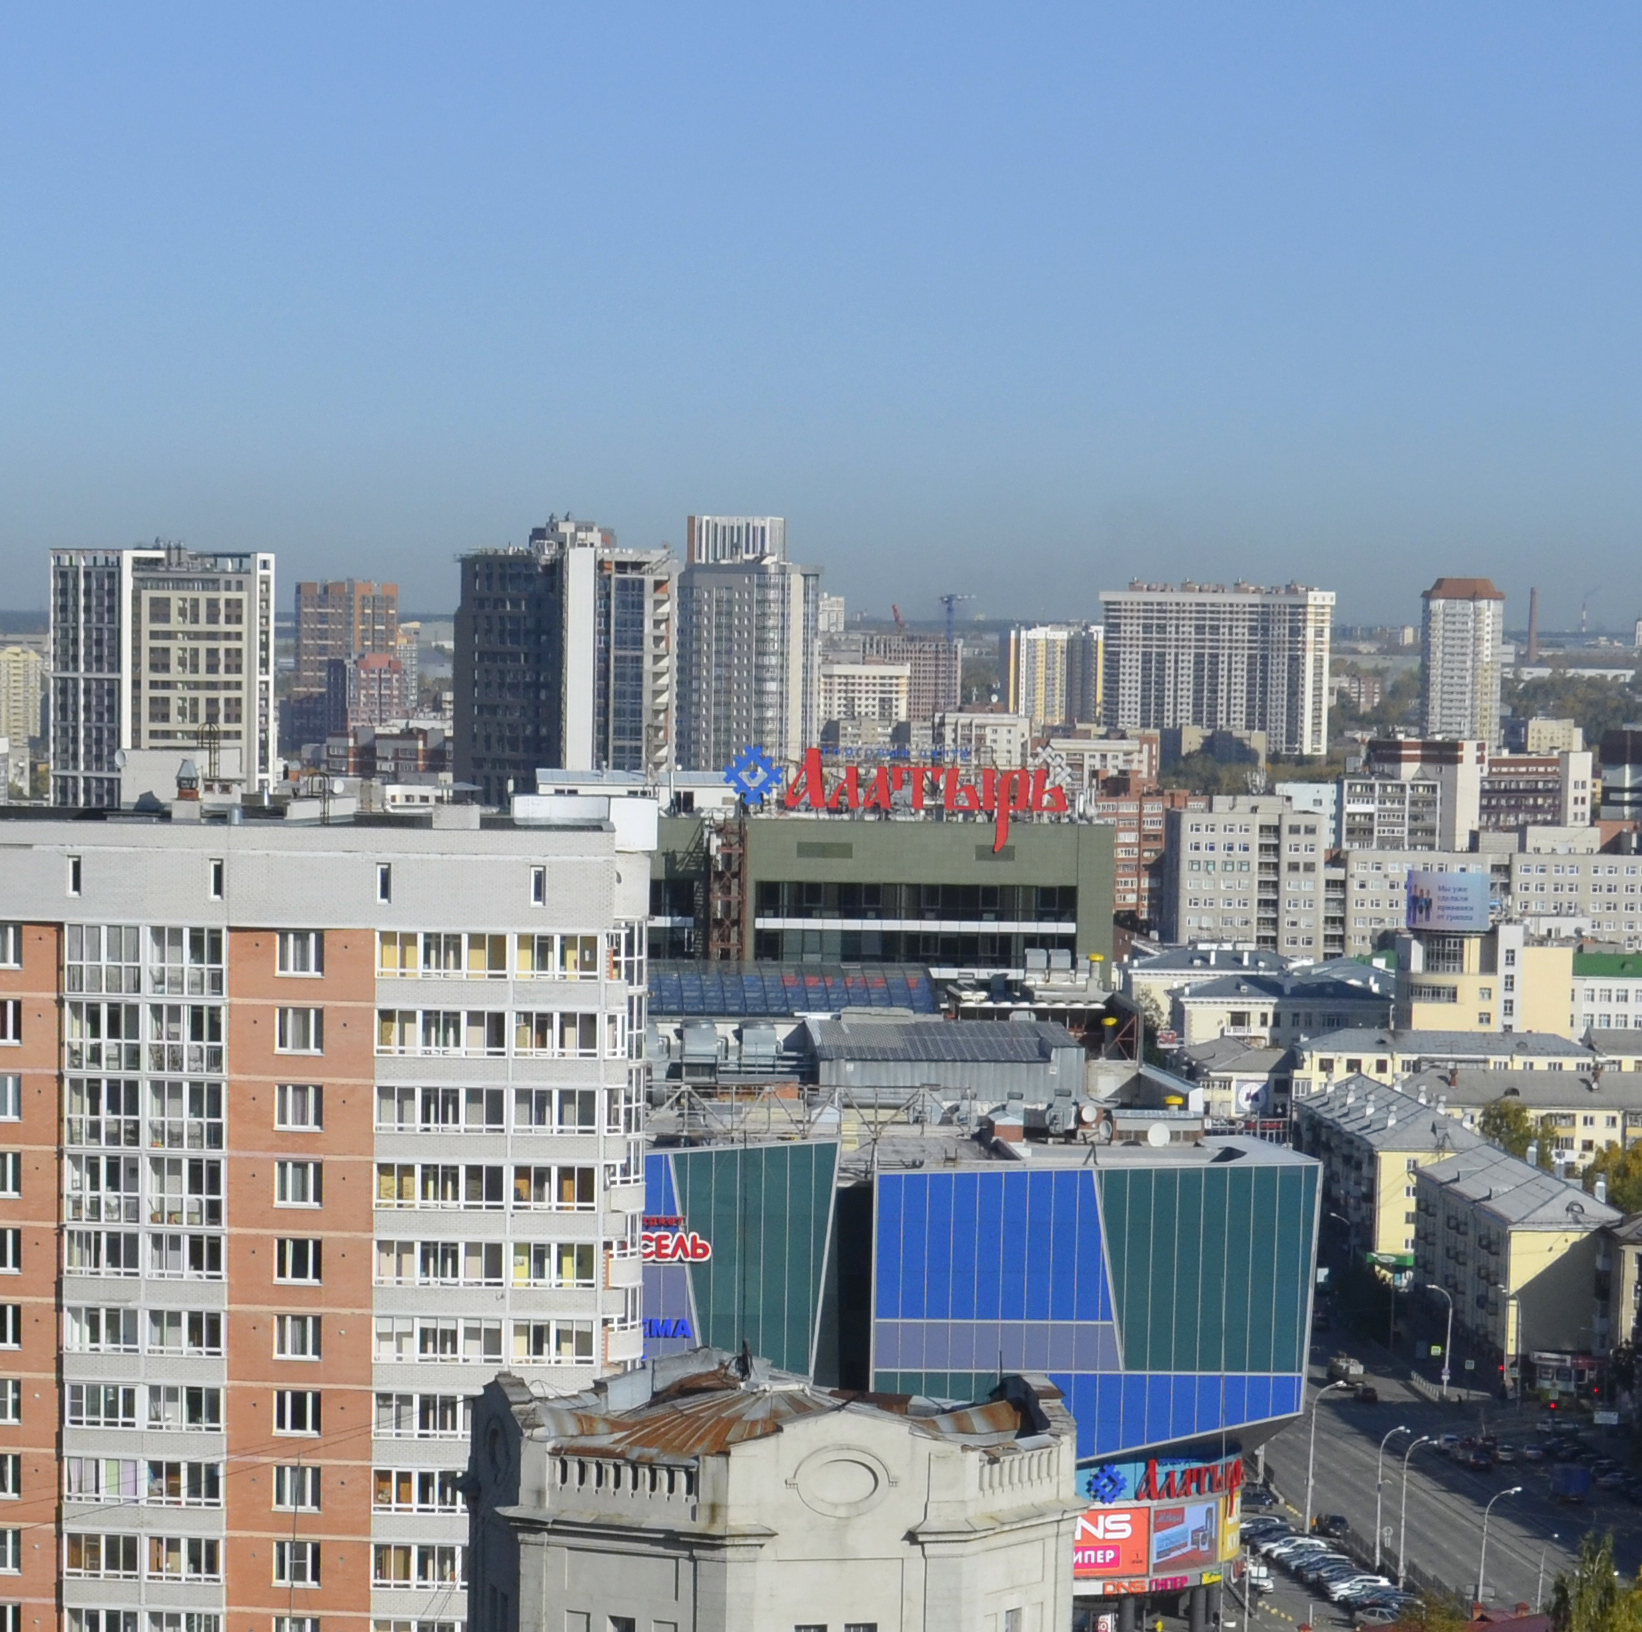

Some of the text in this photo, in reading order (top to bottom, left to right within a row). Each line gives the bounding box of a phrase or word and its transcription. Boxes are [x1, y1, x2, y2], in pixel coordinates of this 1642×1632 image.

[784, 748, 1068, 853] Алатырь
[1103, 1580, 1146, 1596] DNS
[1150, 1576, 1189, 1592] ГИПЕР
